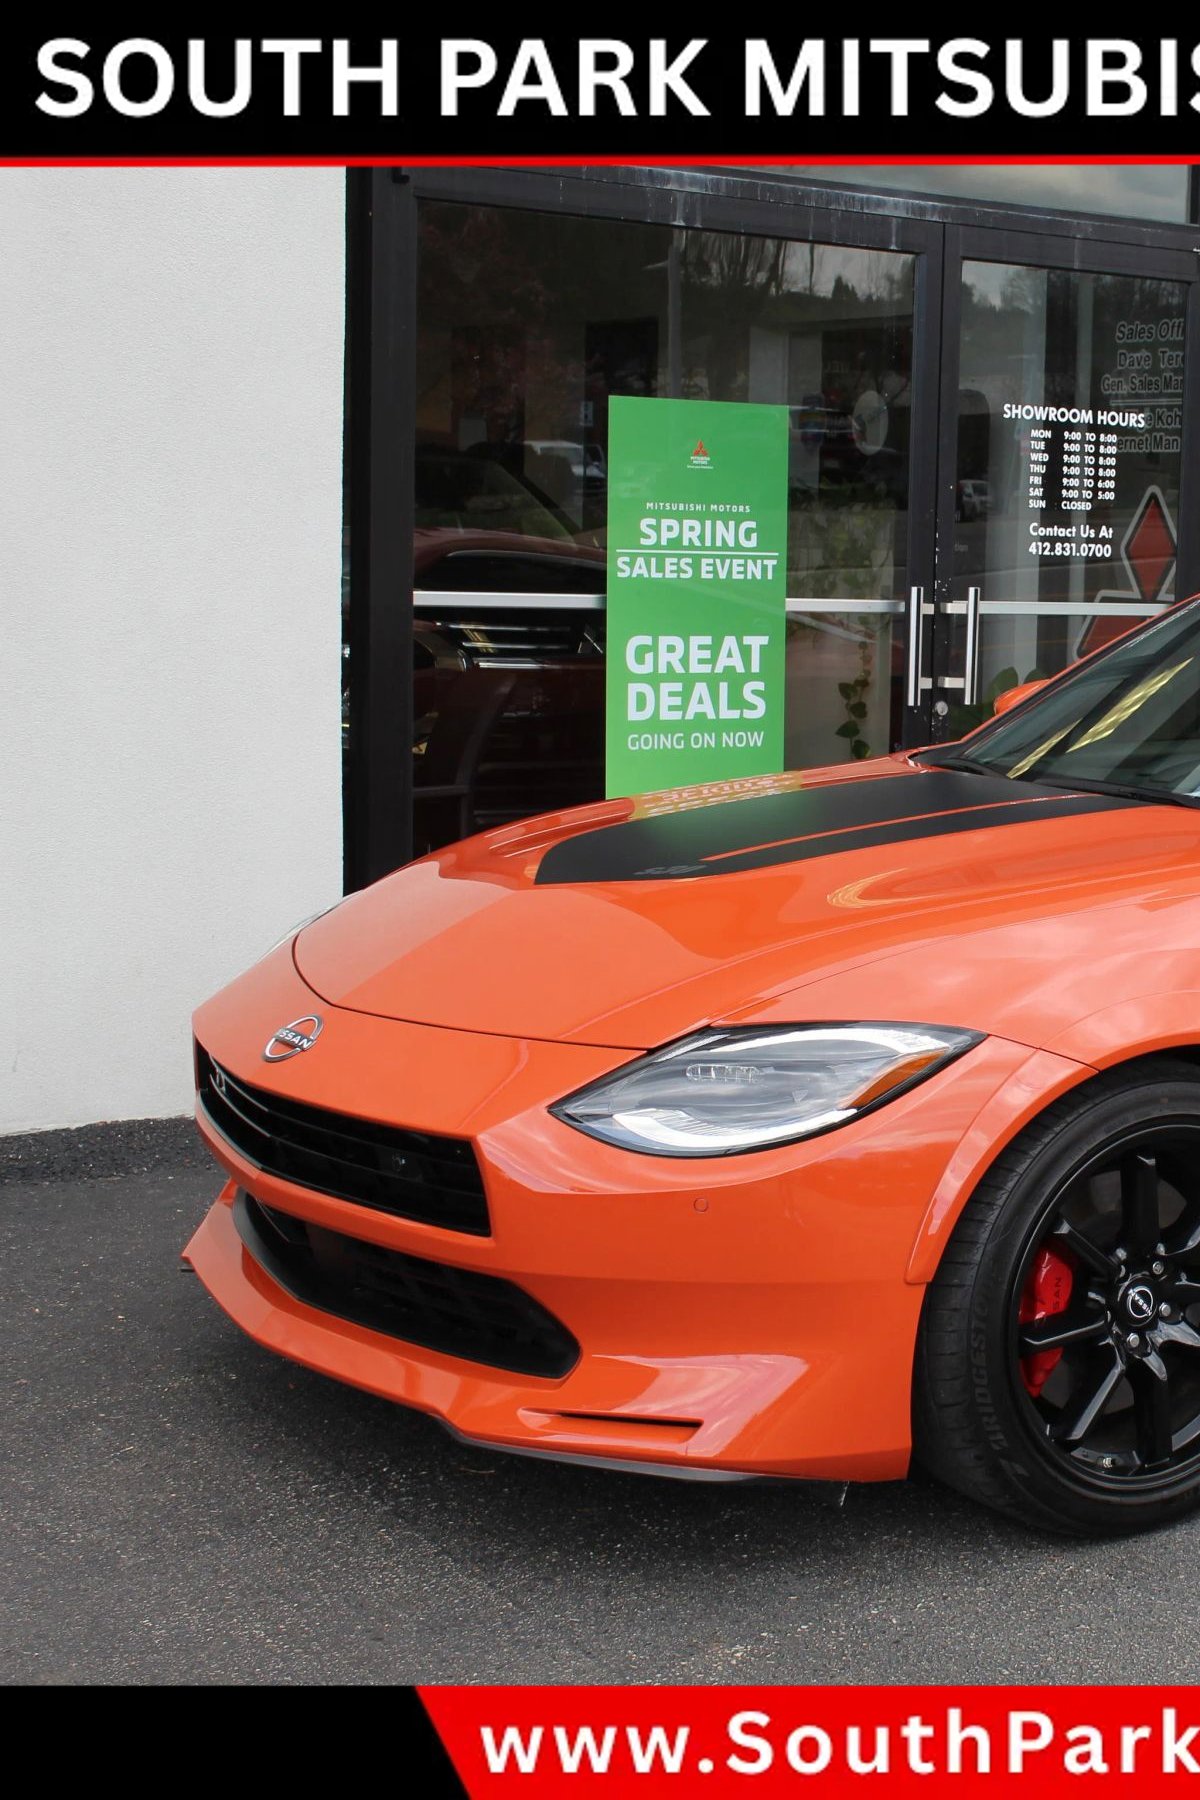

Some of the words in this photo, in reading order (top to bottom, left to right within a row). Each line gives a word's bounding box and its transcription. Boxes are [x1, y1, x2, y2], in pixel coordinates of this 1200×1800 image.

[1116, 321, 1155, 342] Sales
[1118, 350, 1152, 369] Dave
[1101, 374, 1127, 394] Gen.
[1129, 373, 1161, 393] Sales
[1003, 404, 1093, 423] SHOWROOM
[1098, 411, 1145, 427] HOURS
[1031, 429, 1051, 438] MON
[1064, 431, 1081, 440] 9:00
[1086, 433, 1096, 441] TO
[1100, 434, 1117, 442] 8:00
[1030, 441, 1045, 449] TUE
[1064, 443, 1080, 452] 9:00
[1084, 444, 1094, 453] TO
[1100, 445, 1117, 454] 8:00
[1030, 452, 1049, 461] WED
[1063, 455, 1080, 463] 9:00
[1084, 456, 1095, 464] TO
[1099, 457, 1116, 465] 8:00
[1030, 464, 1046, 473] THU
[1063, 466, 1080, 475] 9:00
[1084, 467, 1094, 476] TO
[1099, 468, 1115, 477] 8:00
[1030, 476, 1042, 484] FRI
[1063, 478, 1079, 486] 9:00
[1083, 479, 1094, 487] TO
[1098, 480, 1115, 488] 6:00
[1029, 487, 1043, 496] SAT
[1062, 489, 1078, 498] 9:00
[1082, 490, 1092, 499] TO
[1098, 491, 1114, 500] 5:00
[647, 502, 705, 510] MITSUBISHI
[711, 504, 750, 512] MOTORS
[1029, 499, 1045, 508] SUN
[1062, 501, 1091, 510] CLOSED
[640, 518, 757, 547] SPRING
[1030, 522, 1076, 537] Contact
[1080, 525, 1095, 537] Us
[1099, 526, 1113, 538] At
[1029, 542, 1111, 557] 412.831.0700
[617, 557, 692, 578] SALES
[701, 559, 778, 579] EVENT
[626, 636, 768, 674] GREAT
[628, 681, 765, 721] DEALS
[628, 733, 684, 750] GOING
[691, 733, 715, 748] ON
[723, 732, 763, 747] NOW
